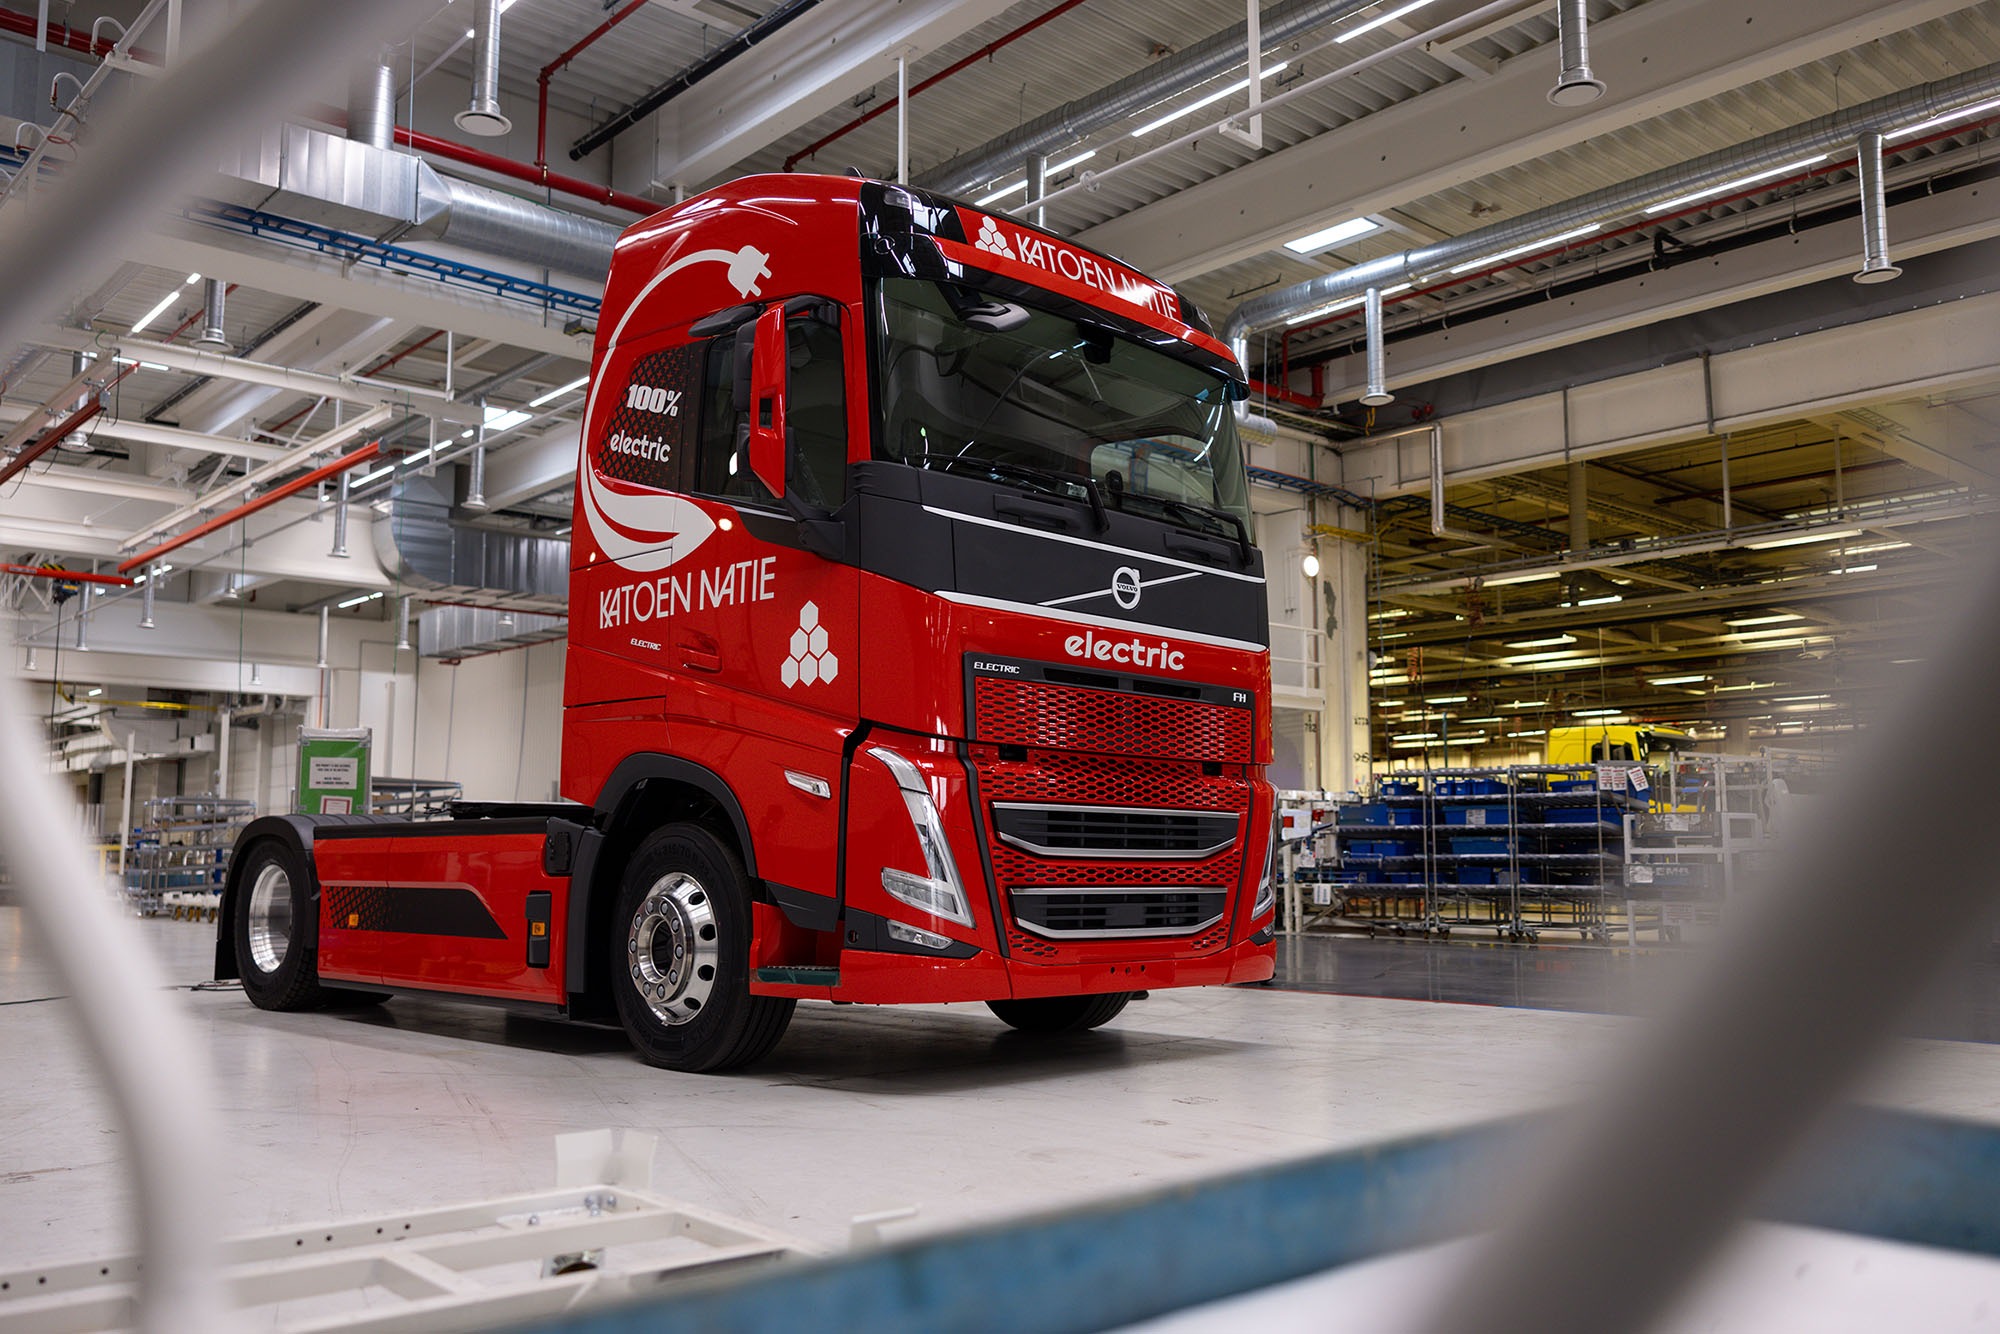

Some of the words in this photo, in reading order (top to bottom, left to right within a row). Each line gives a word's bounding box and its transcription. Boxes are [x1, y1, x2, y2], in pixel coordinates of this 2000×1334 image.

[1015, 232, 1116, 294] KATOEN
[626, 384, 682, 417] 100%
[610, 430, 671, 463] electric
[600, 572, 692, 630] KATOEN
[699, 556, 776, 610] NATIE
[1116, 583, 1138, 592] VOLVO
[630, 637, 662, 651] ELECTRIC
[1064, 631, 1185, 671] electric
[973, 661, 1020, 674] ELECTRIC
[1233, 691, 1246, 703] FH
